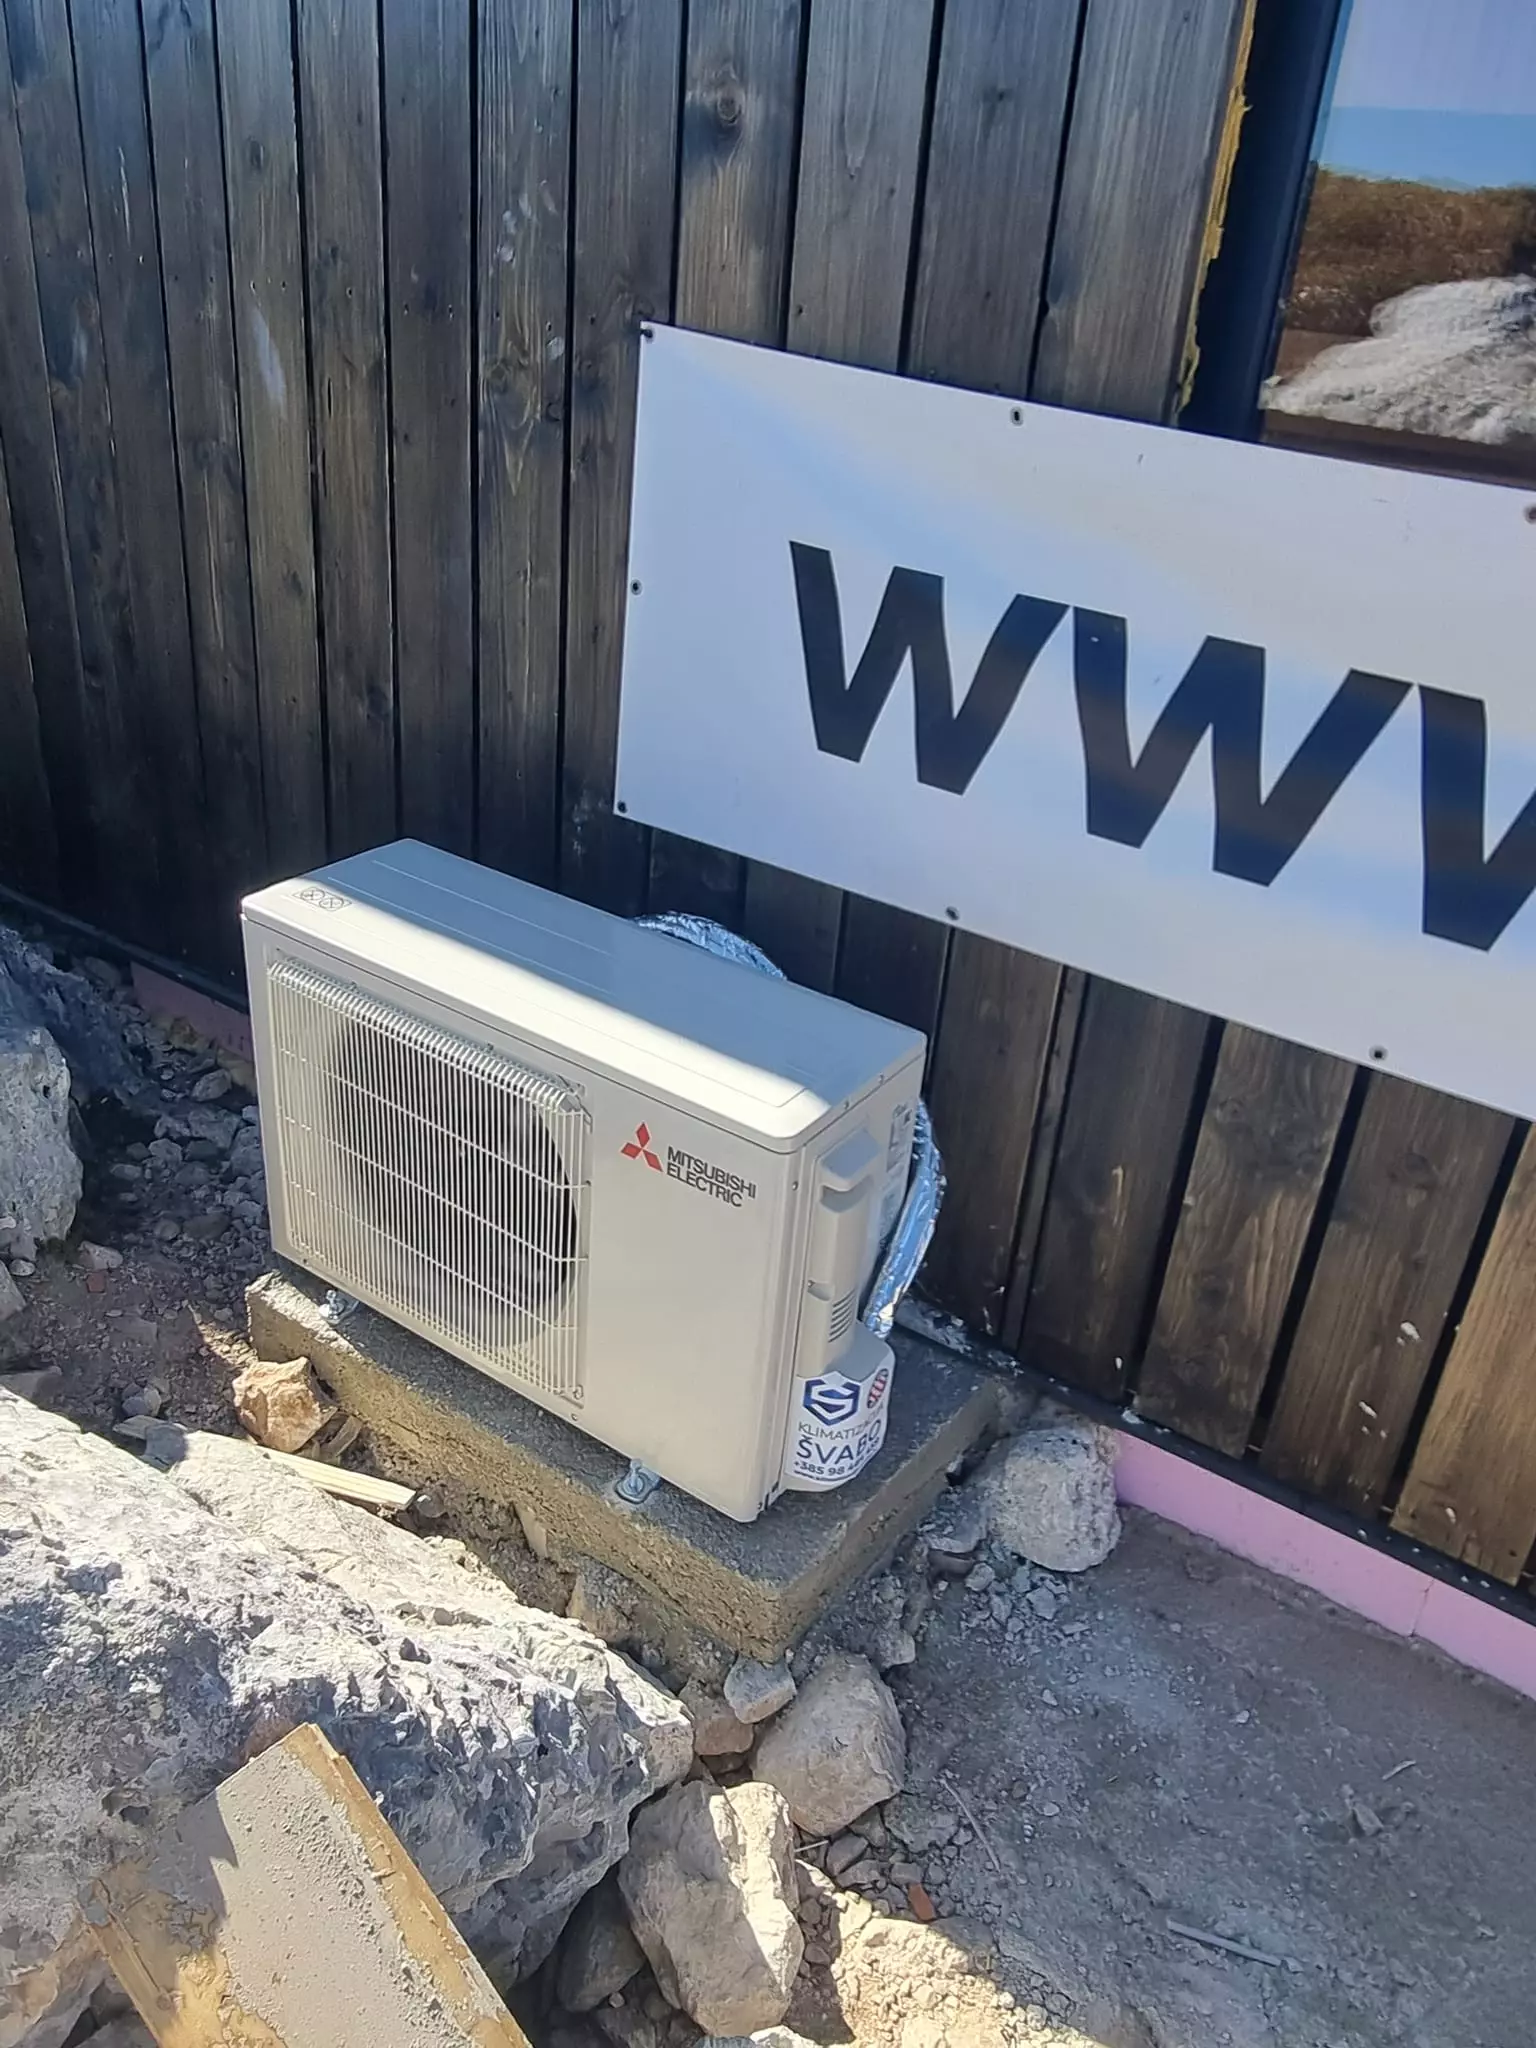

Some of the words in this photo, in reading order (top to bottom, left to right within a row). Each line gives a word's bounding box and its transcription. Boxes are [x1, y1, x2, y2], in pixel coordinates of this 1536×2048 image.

[666, 1161, 743, 1208] ELECTRIC
[667, 1145, 756, 1199] MITSUBISHI
[796, 1419, 882, 1465] ŠVABO
[794, 1460, 826, 1475] +385
